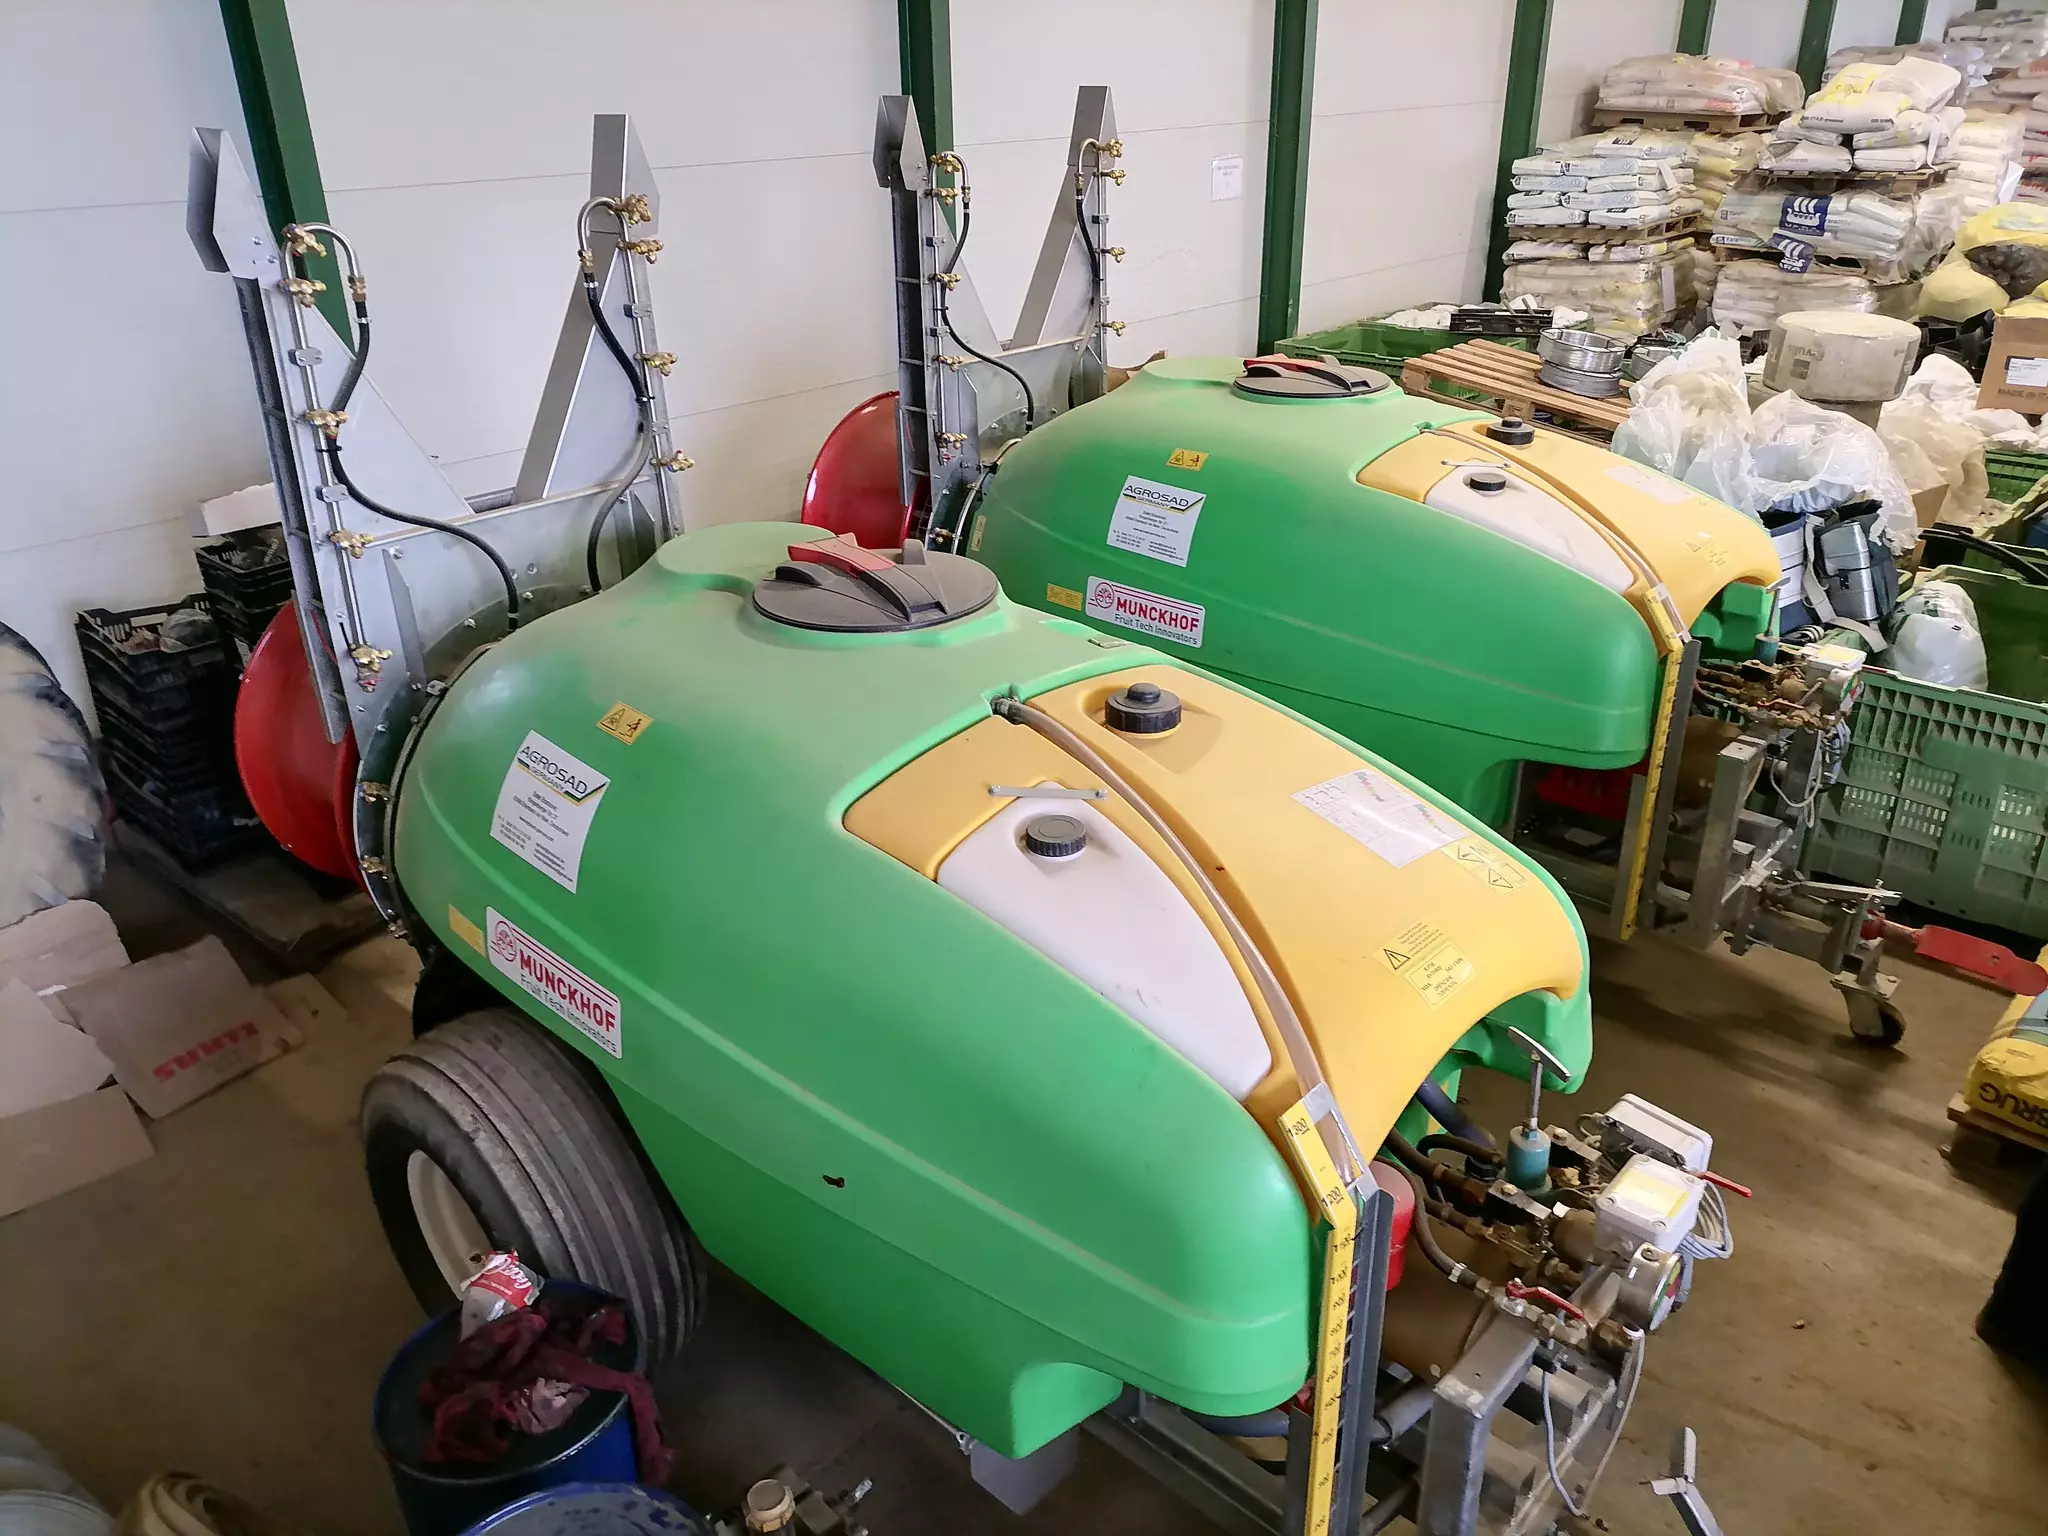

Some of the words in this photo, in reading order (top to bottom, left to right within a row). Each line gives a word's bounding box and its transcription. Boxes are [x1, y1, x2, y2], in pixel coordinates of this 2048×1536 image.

[1124, 485, 1190, 508] AGROSAD
[1114, 613, 1135, 628] Fruit
[1135, 618, 1154, 633] Tech
[1154, 623, 1198, 645] Innovators
[1115, 596, 1201, 633] MUNCKHOF
[518, 744, 589, 795] AGROSAD
[519, 947, 617, 1033] MUNCKHOF
[519, 972, 542, 999] Fruit
[542, 988, 566, 1017] Tech
[565, 1003, 618, 1053] Innovators
[1287, 1118, 1311, 1138] 1300
[1321, 1186, 1345, 1208] 1200
